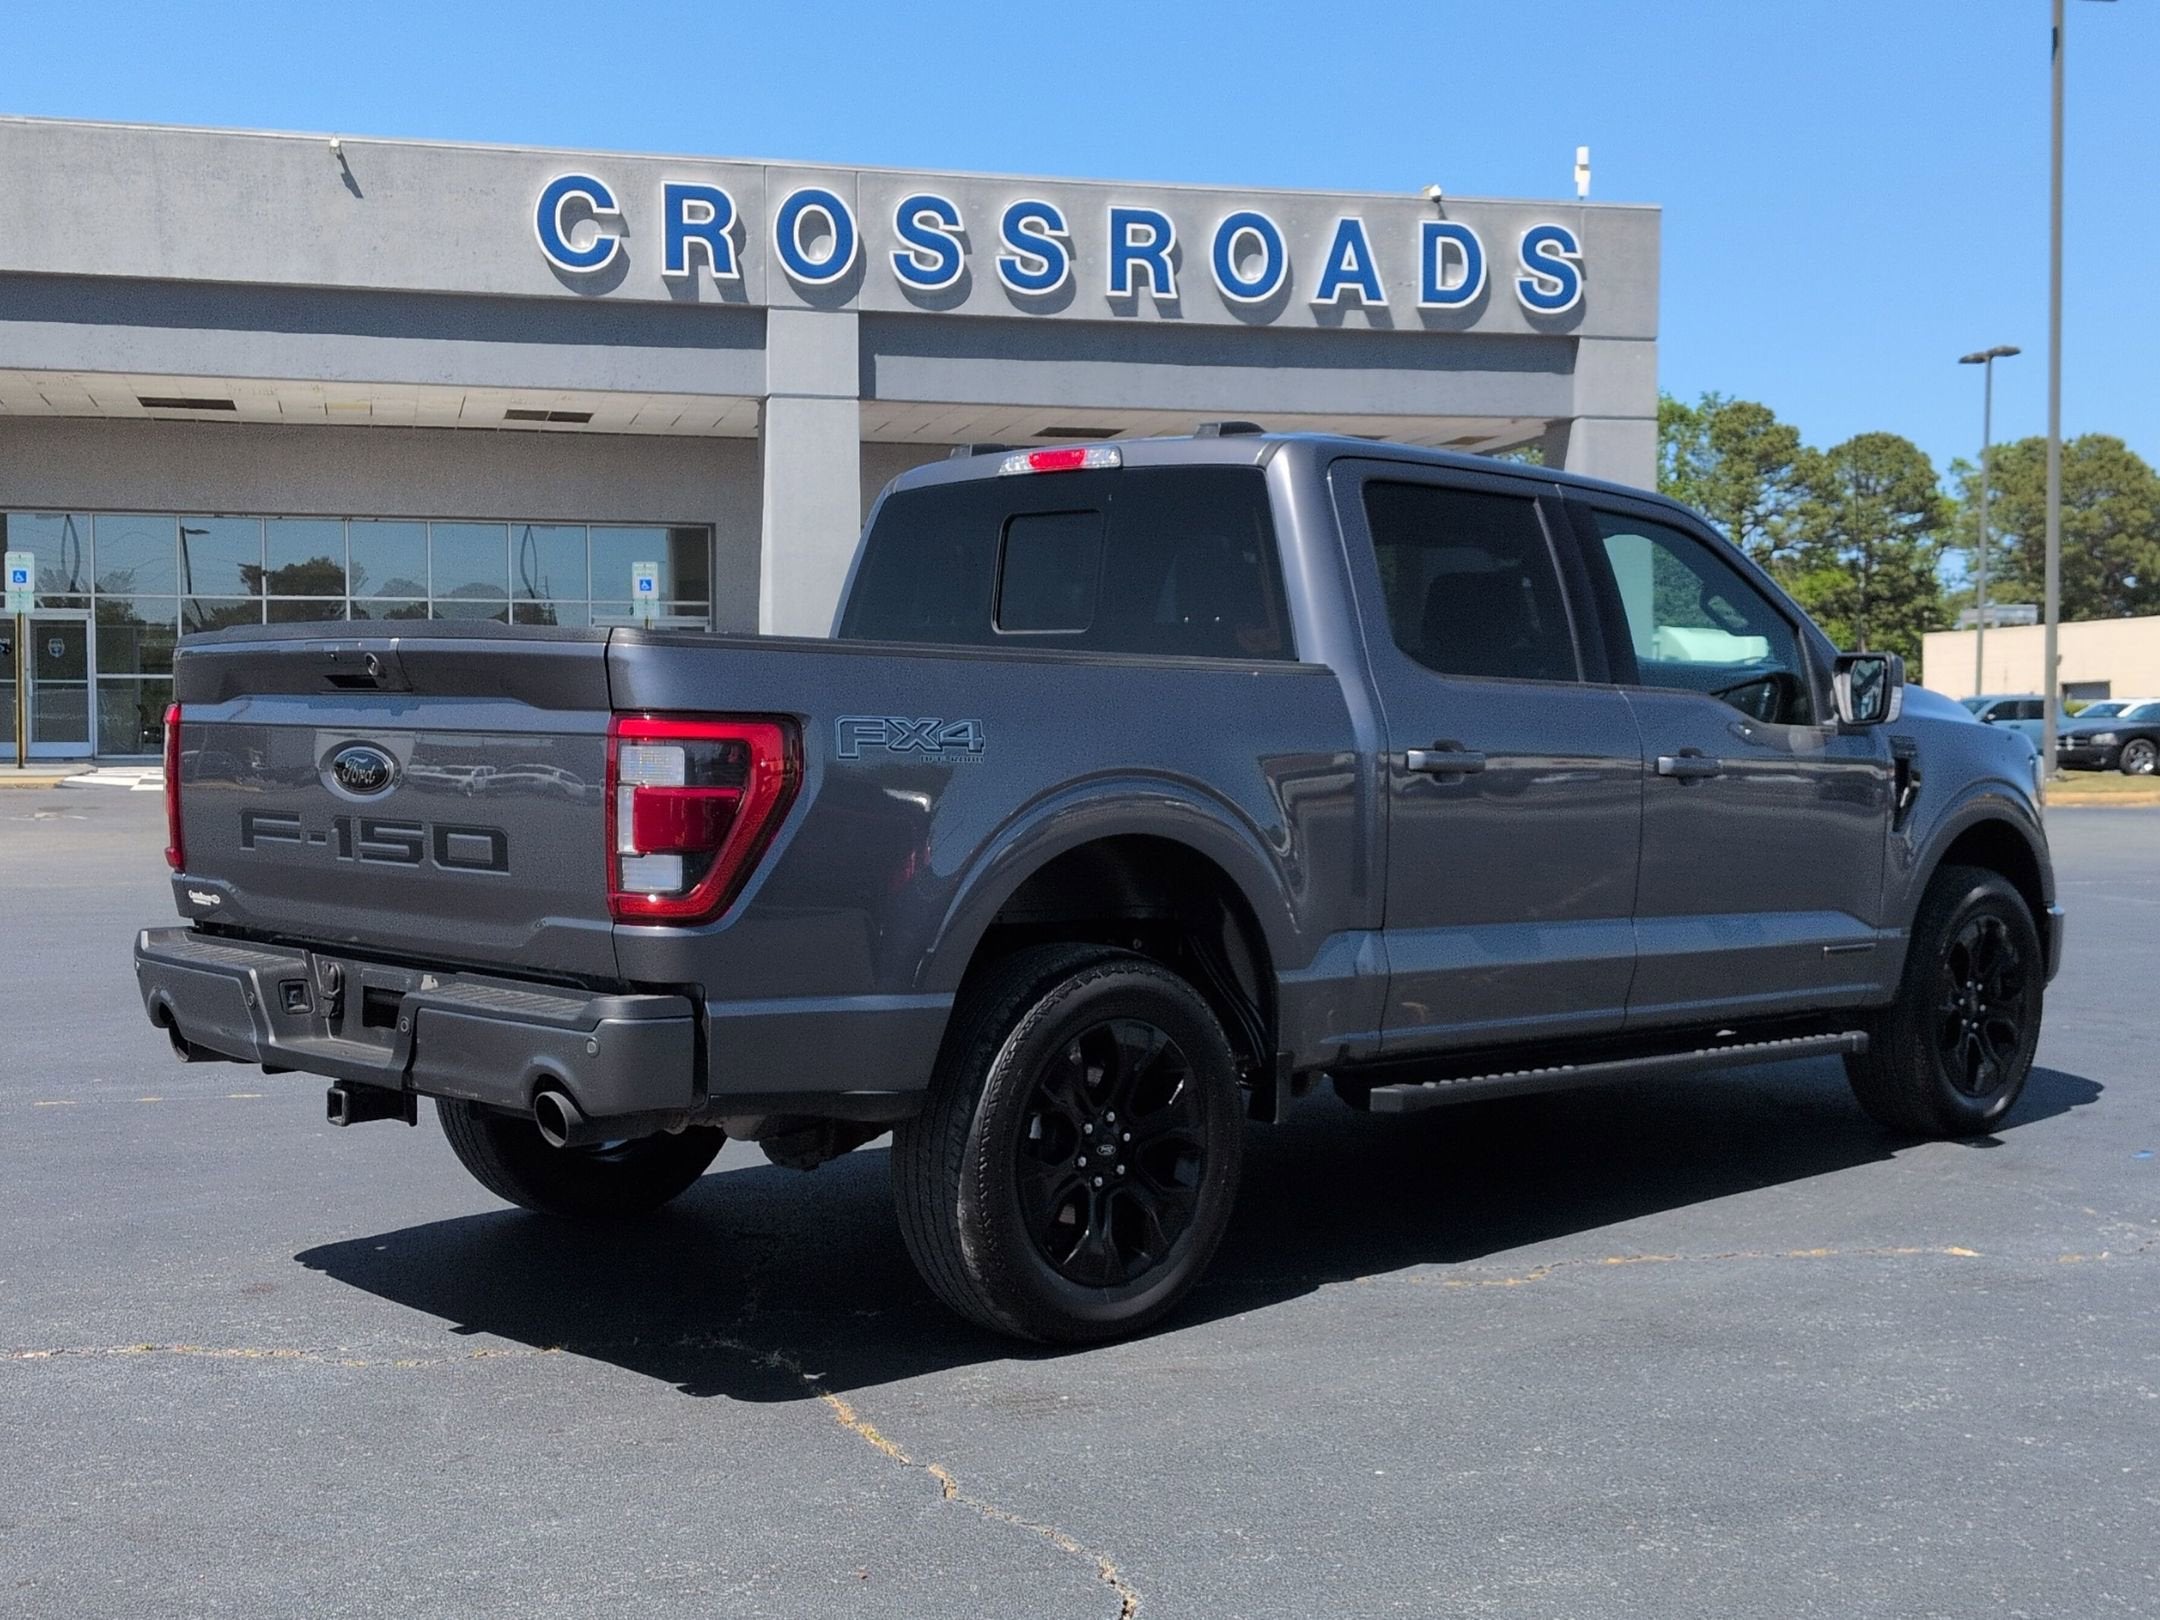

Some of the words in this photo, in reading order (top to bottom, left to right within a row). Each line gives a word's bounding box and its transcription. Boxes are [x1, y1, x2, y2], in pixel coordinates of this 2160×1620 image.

[534, 172, 1583, 314] CROSSROADS
[835, 715, 986, 761] FX4
[341, 756, 376, 784] Ford
[240, 808, 511, 876] F-150
